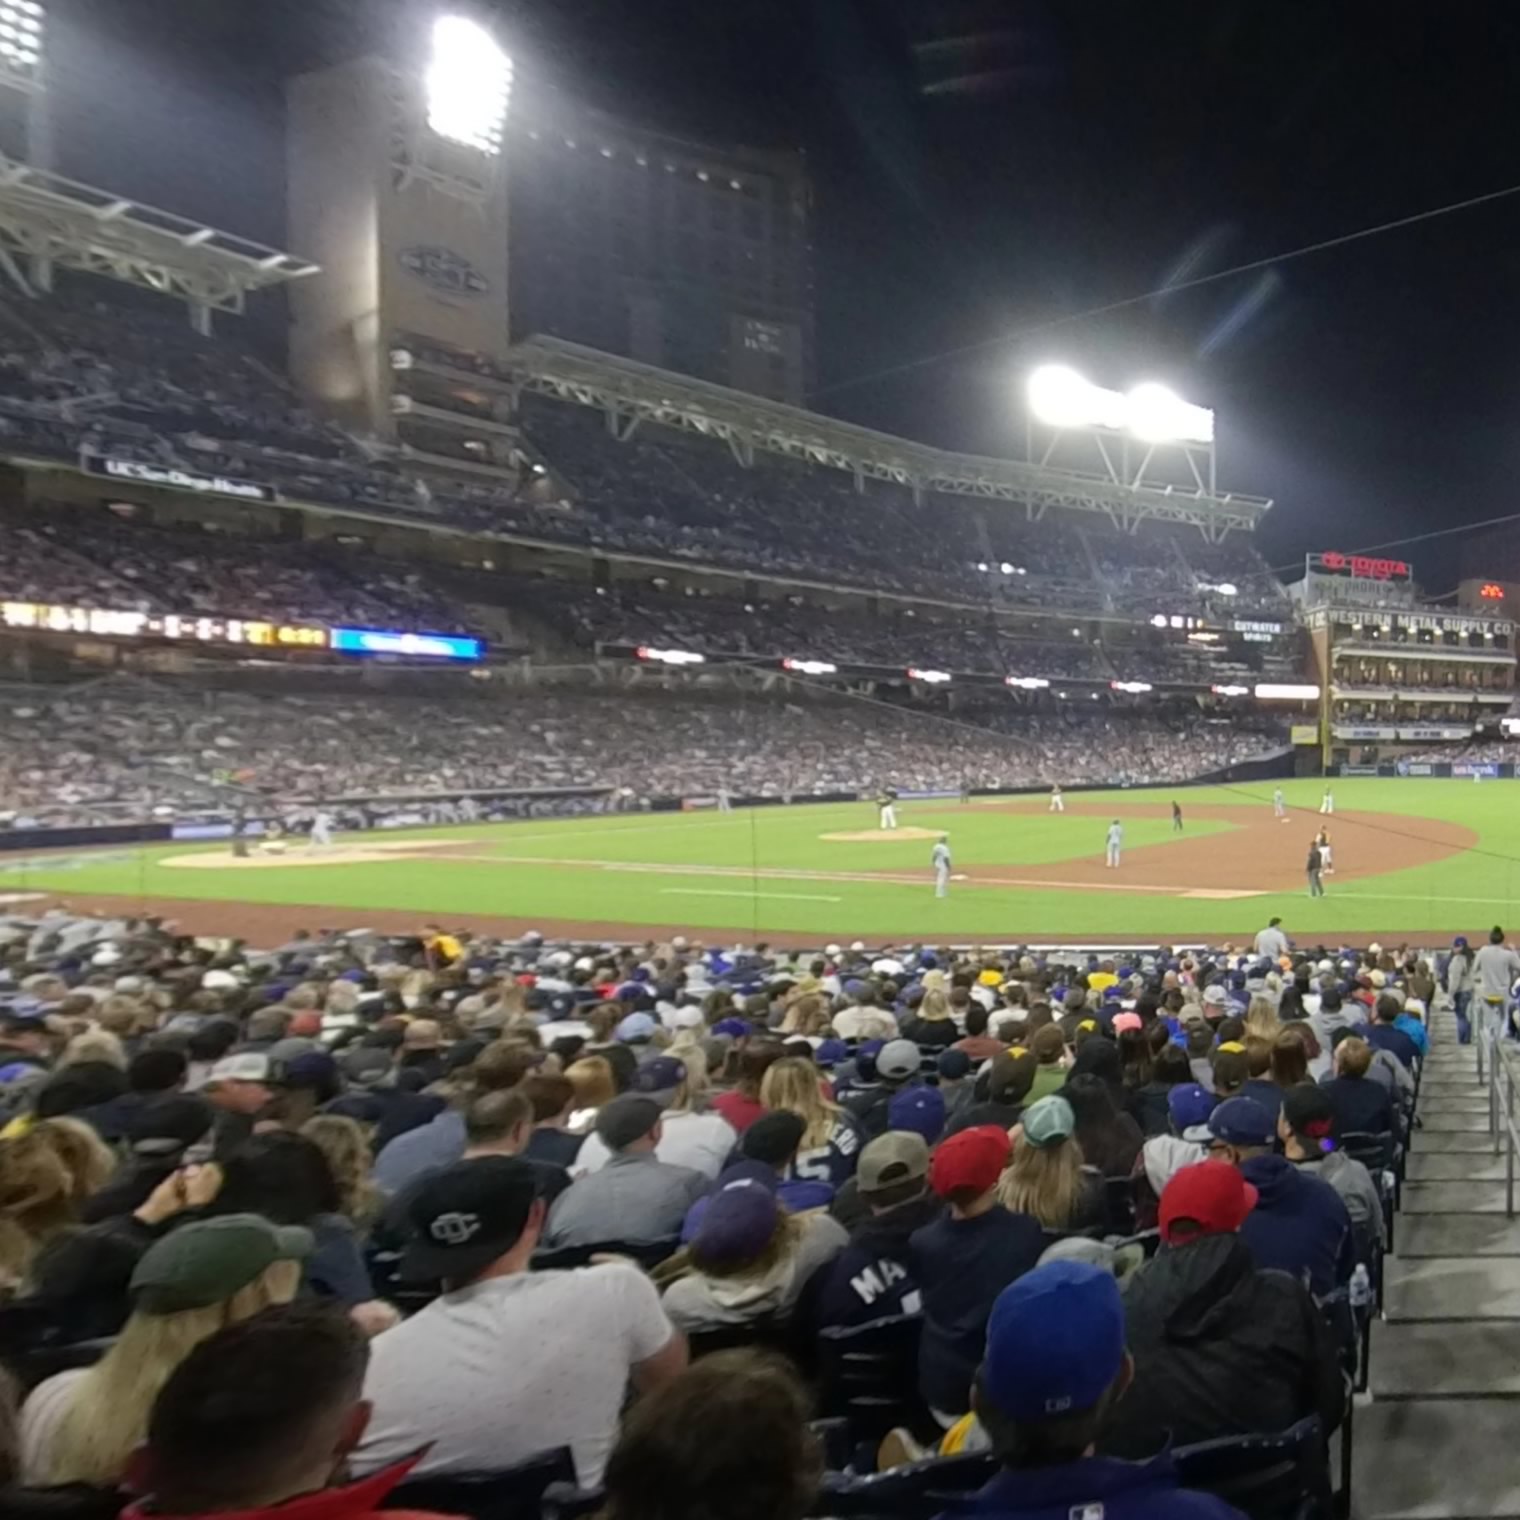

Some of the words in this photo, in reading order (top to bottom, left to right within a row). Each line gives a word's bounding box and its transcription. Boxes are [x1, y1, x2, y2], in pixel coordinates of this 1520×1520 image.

[1328, 610, 1393, 627] WESTERN
[1398, 615, 1440, 630] METAL
[1443, 618, 1490, 636] SUPPLY
[850, 1257, 907, 1305] MA
